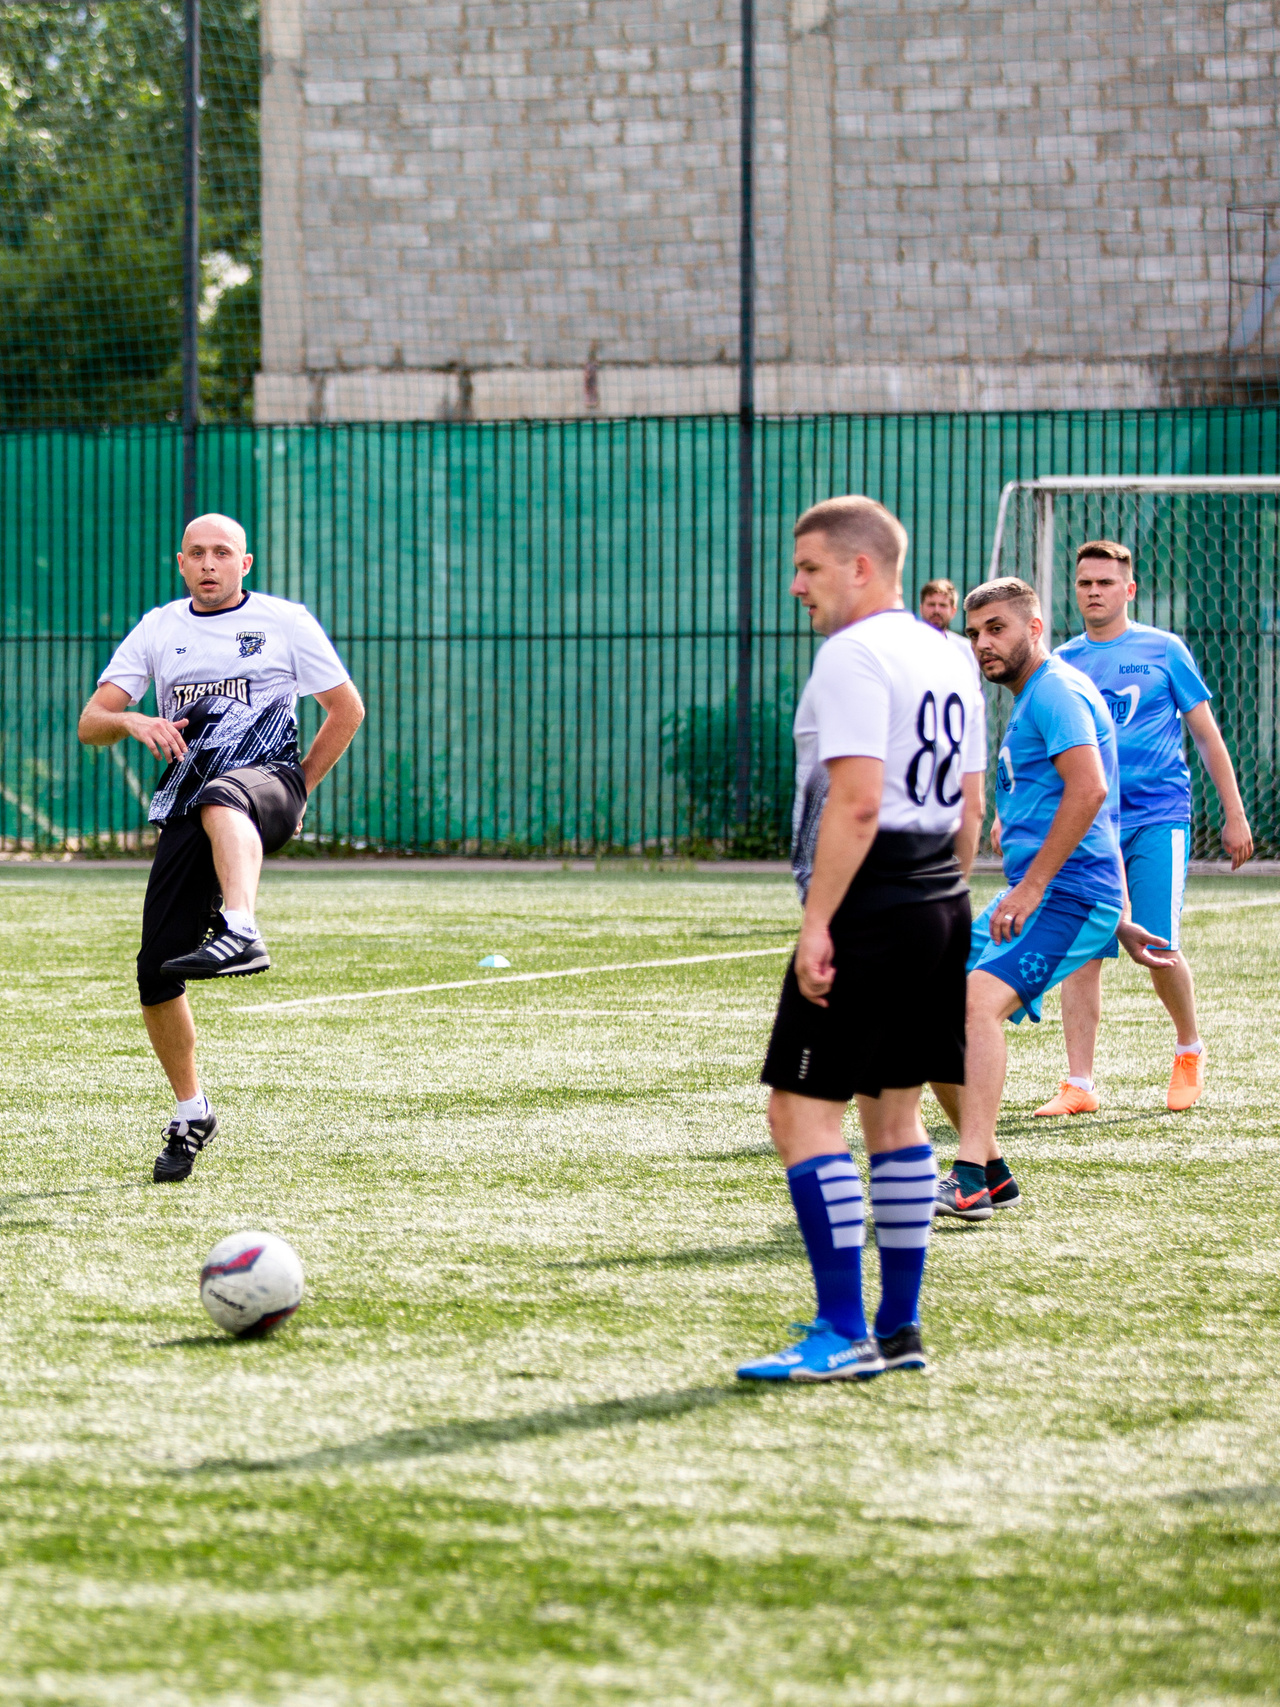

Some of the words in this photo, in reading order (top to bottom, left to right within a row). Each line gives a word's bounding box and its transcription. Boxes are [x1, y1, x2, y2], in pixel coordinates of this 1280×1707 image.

[1119, 663, 1150, 675] Iceberg
[173, 678, 249, 711] TORNADO
[905, 690, 965, 807] 88
